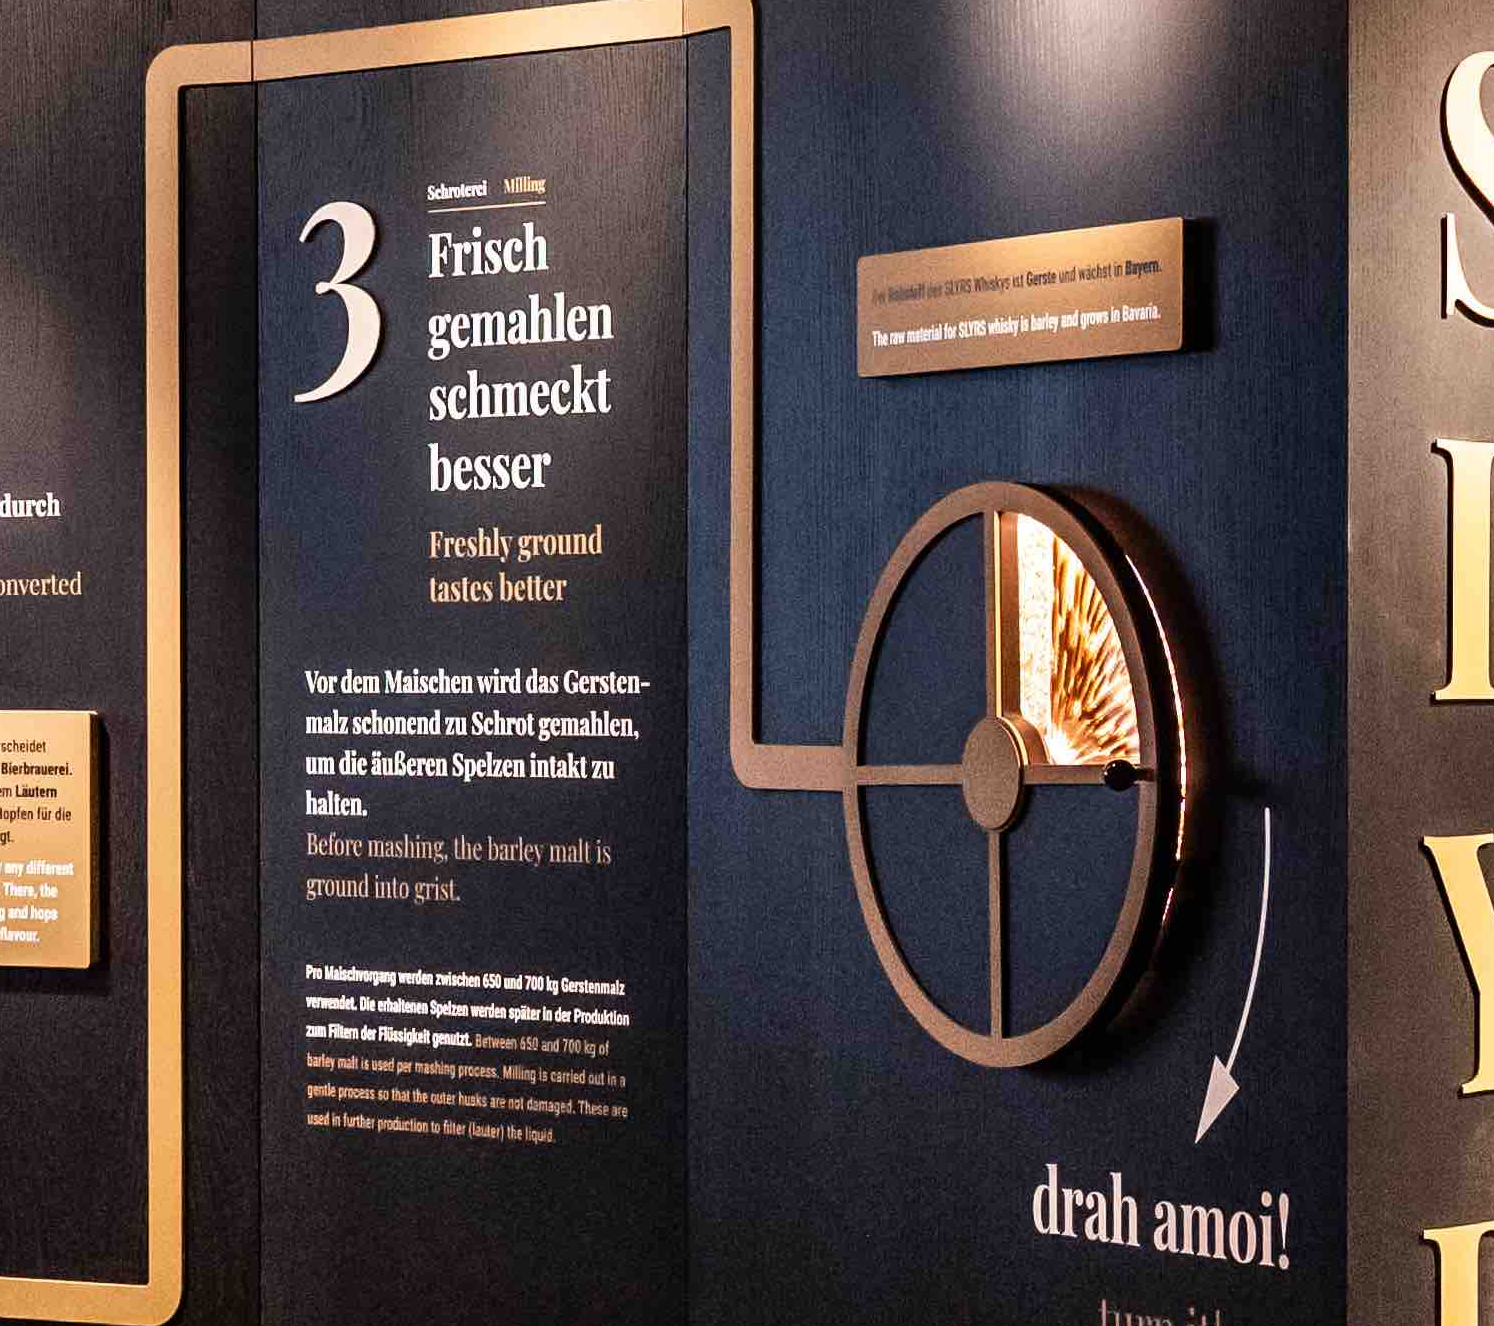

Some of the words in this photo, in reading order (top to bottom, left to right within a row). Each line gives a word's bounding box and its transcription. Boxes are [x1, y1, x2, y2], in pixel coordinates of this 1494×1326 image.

[428, 179, 487, 201] Schroterei
[505, 176, 546, 195] Milling
[429, 221, 548, 278] Frisch
[295, 201, 380, 403] 3
[428, 292, 614, 361] gemahlen
[872, 330, 888, 347] The
[890, 330, 905, 345] raw
[907, 323, 942, 343] material
[944, 322, 957, 340] for
[959, 319, 986, 339] SLYRS
[988, 315, 1019, 338] whisky
[1021, 314, 1028, 332] is
[1031, 312, 1059, 334] barley
[1061, 309, 1079, 329] and
[1081, 307, 1108, 331] grows
[1111, 306, 1120, 323] in
[1122, 302, 1161, 322] Bavaria.
[430, 364, 611, 421] schmeckt
[428, 442, 551, 491] besser
[431, 527, 513, 563] Freshly
[518, 524, 602, 562] ground
[430, 577, 493, 602] tastes
[499, 572, 567, 602] better
[305, 670, 337, 694] Vor
[341, 668, 380, 694] dem
[385, 667, 473, 694] Maischen
[477, 668, 521, 694] wird
[526, 668, 558, 694] das
[564, 670, 650, 694] Gersten-
[306, 709, 348, 735] malz
[353, 709, 441, 736] schonend
[445, 716, 467, 736] zu
[472, 709, 535, 737] Schrot
[538, 711, 639, 741] gemahlen,
[306, 756, 335, 775] um
[339, 750, 367, 776] die
[371, 750, 448, 777] äußeren
[452, 751, 525, 783] Spelzen
[530, 752, 587, 779] intakt
[592, 760, 614, 780] zu
[306, 790, 367, 817] halten.
[308, 831, 362, 857] Before
[369, 834, 447, 863] mashing,
[455, 834, 482, 860] the
[488, 836, 540, 867] barley
[550, 838, 589, 863] malt
[597, 839, 611, 864] is
[307, 873, 368, 900] ground
[375, 874, 409, 899] into
[415, 876, 460, 904] grist.
[1033, 1163, 1140, 1248] drah
[1154, 1191, 1289, 1270] amoi!
